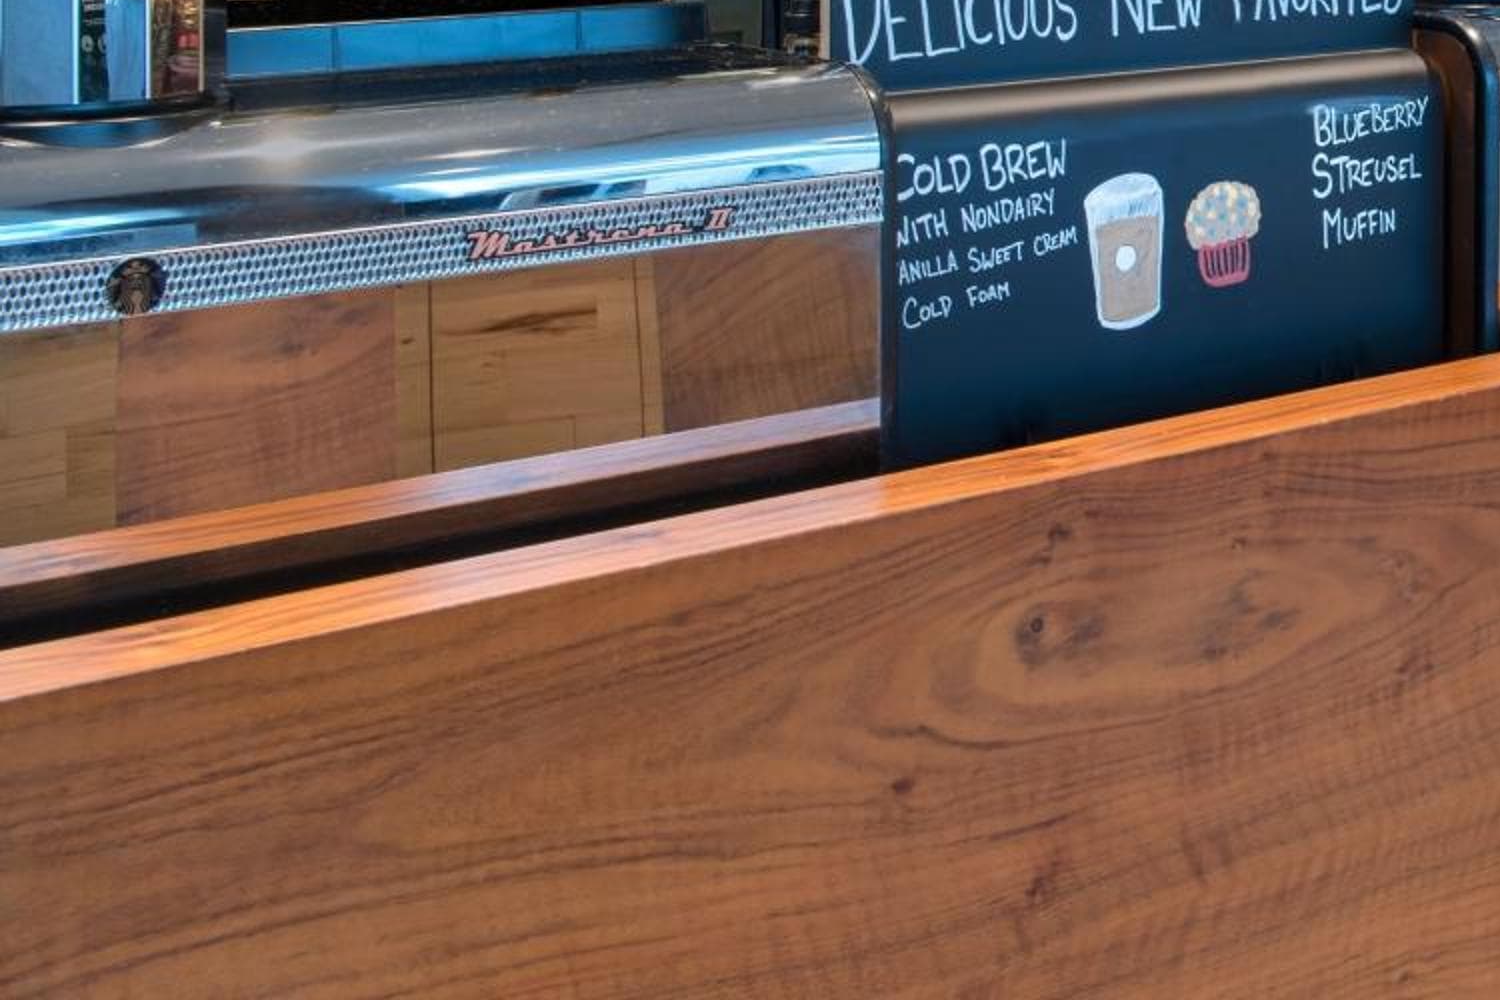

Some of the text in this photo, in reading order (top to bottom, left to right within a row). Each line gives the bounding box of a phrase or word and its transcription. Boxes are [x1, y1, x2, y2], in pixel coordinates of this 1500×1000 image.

[1312, 94, 1430, 147] BLUEBERRY
[896, 137, 1067, 202] COLD BREW
[1311, 152, 1423, 199] STREUSEL
[960, 187, 1056, 234] NONDAIRY
[1322, 207, 1396, 249] MUFFIN
[468, 221, 694, 260] Mastrena
[897, 225, 1080, 286] ANILLA SWEET CREAM
[902, 280, 1011, 330] COLD FOAM
